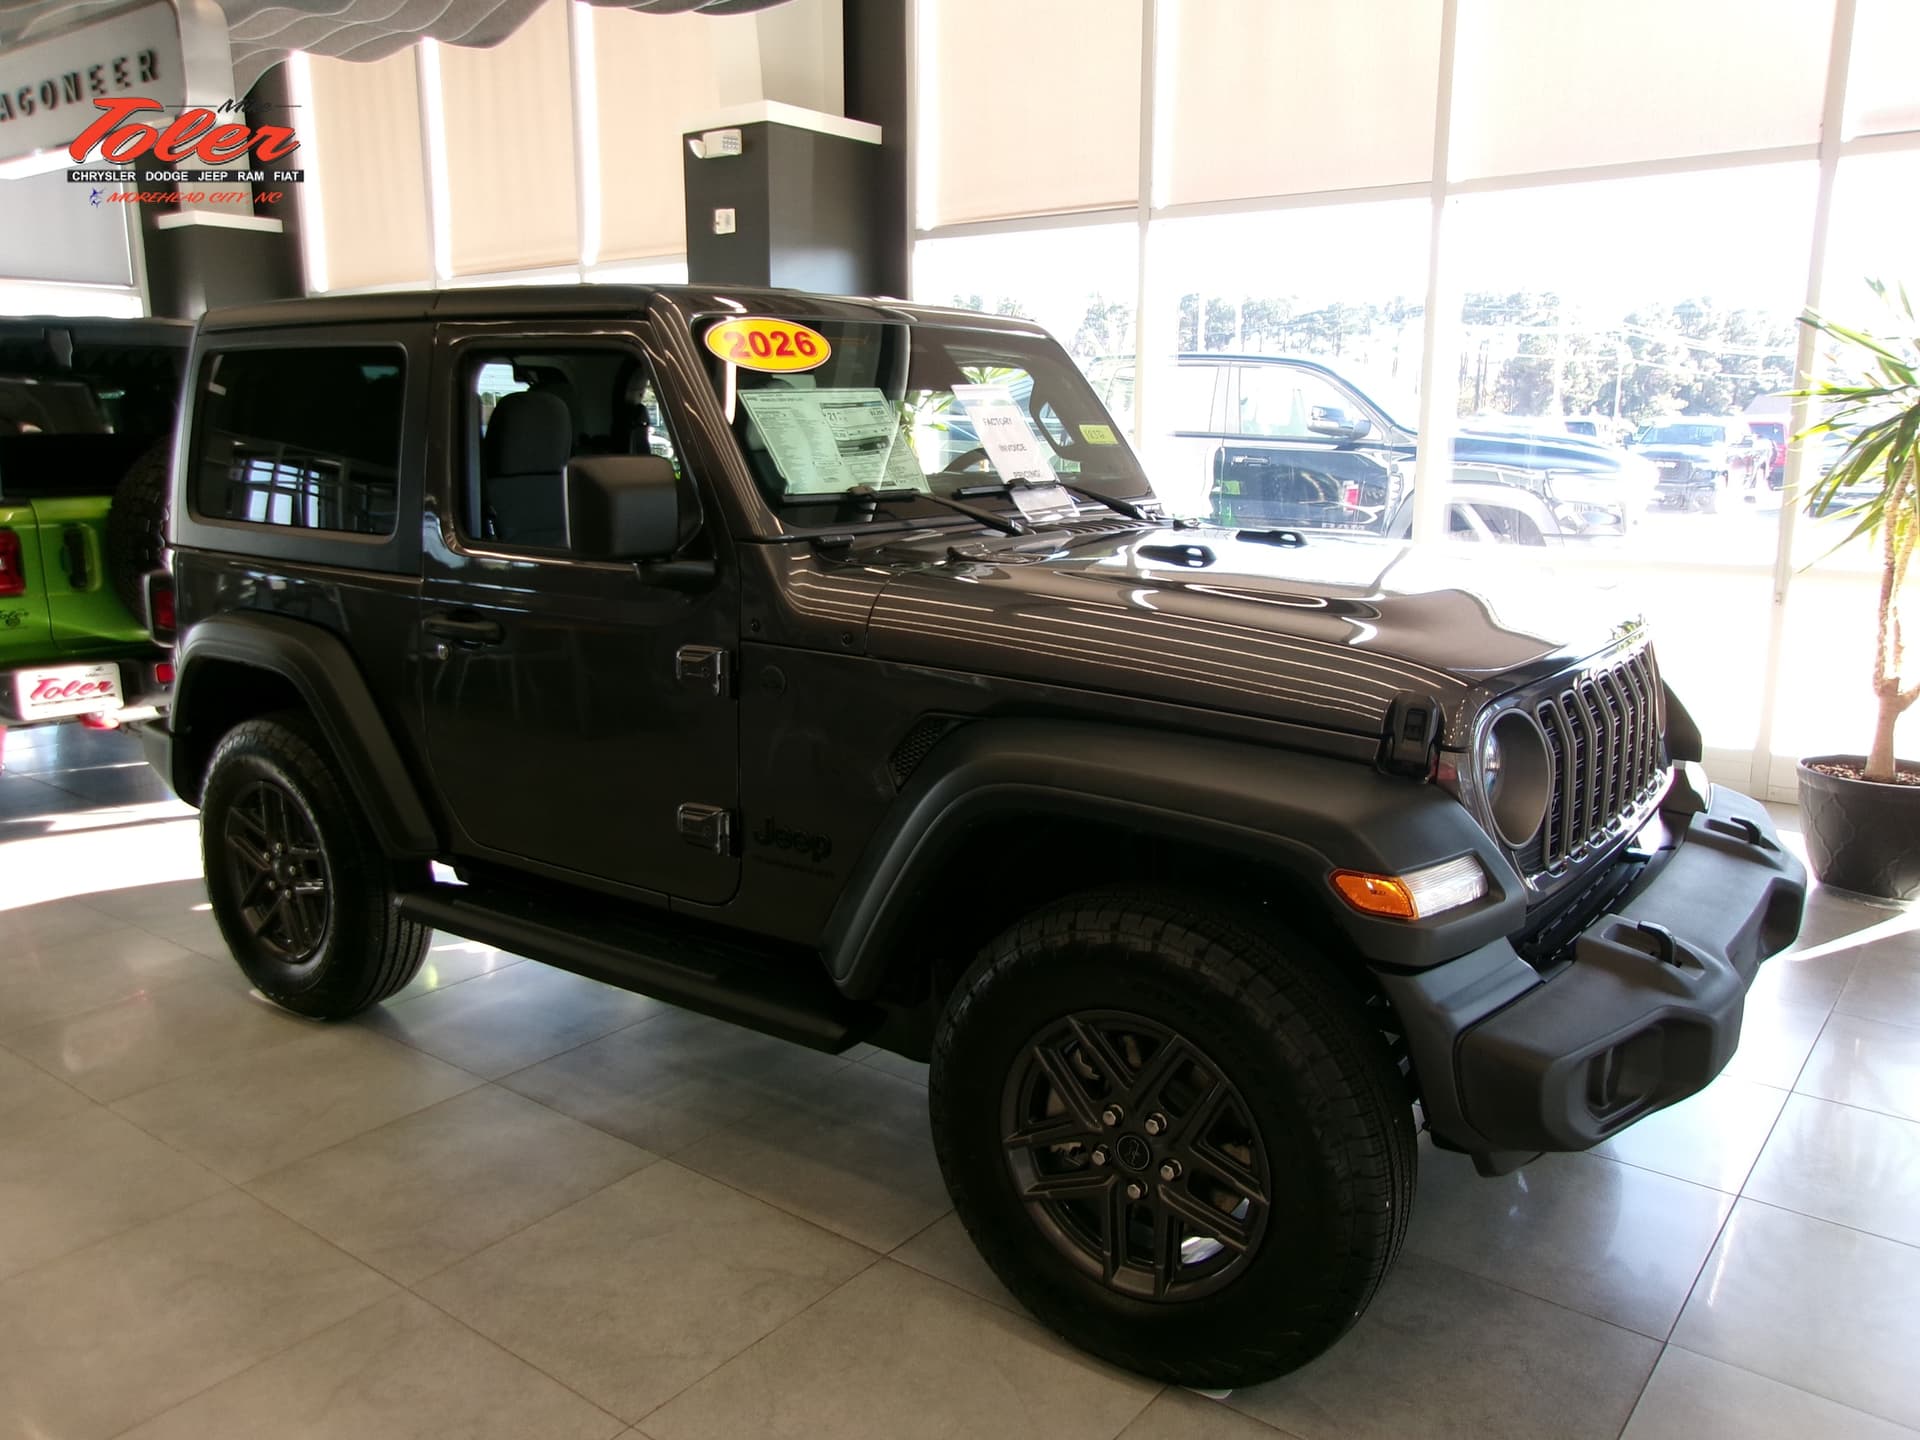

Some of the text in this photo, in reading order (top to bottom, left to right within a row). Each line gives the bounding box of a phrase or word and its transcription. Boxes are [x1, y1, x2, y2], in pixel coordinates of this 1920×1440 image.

[723, 330, 818, 359] 2026
[29, 677, 115, 701] Toler
[752, 815, 833, 863] Jeep
